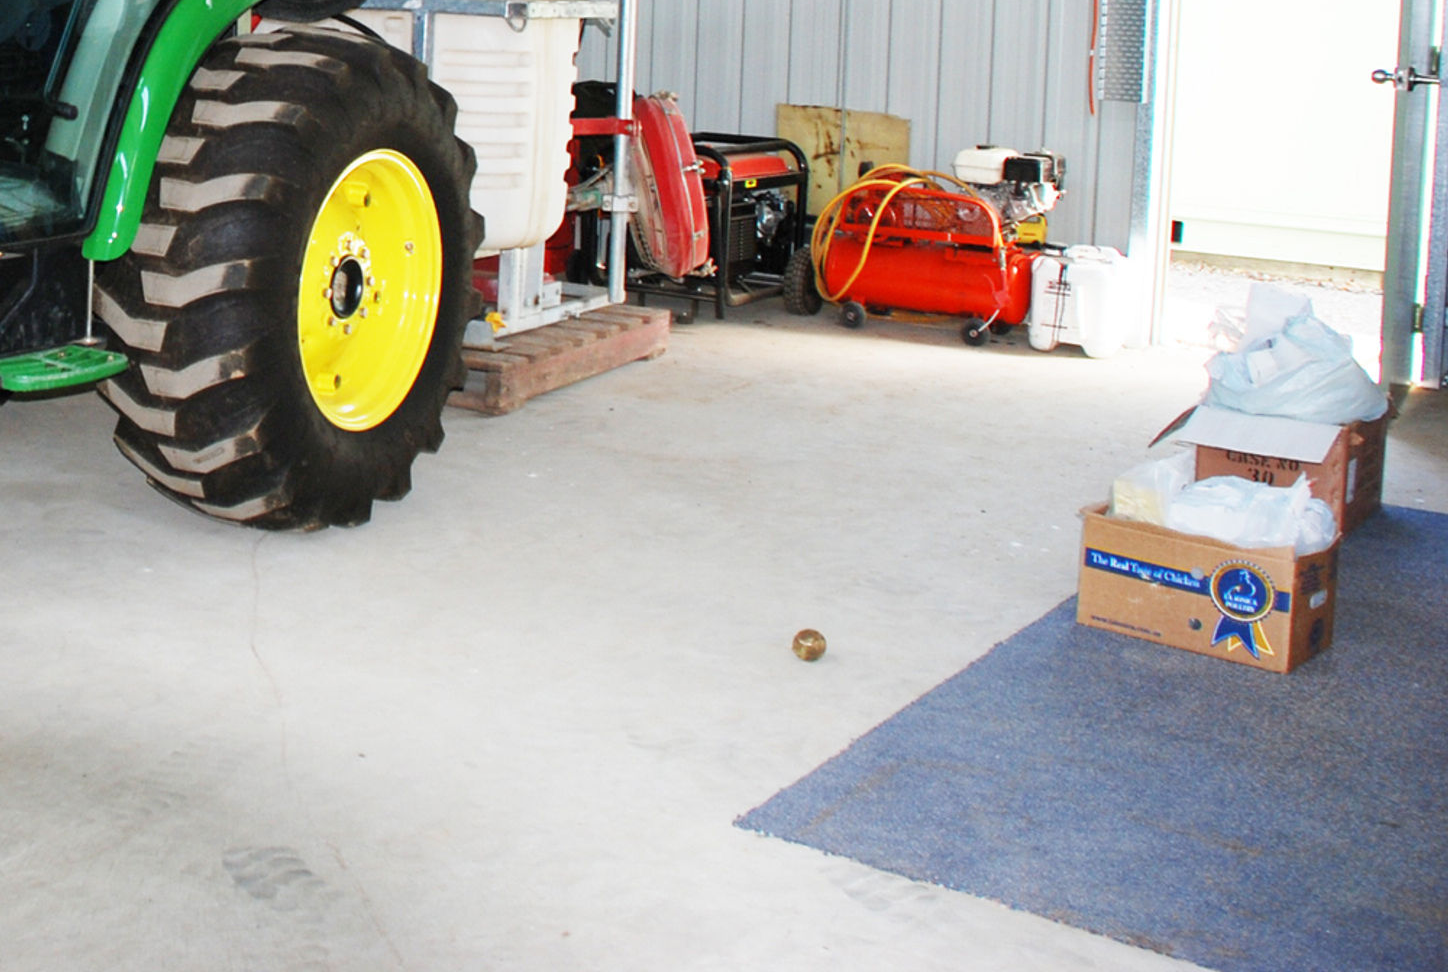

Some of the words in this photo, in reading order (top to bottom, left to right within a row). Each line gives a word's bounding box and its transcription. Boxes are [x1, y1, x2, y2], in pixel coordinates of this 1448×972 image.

[1091, 552, 1108, 565] The
[1110, 556, 1129, 571] Real
[1164, 570, 1200, 587] Chicken
